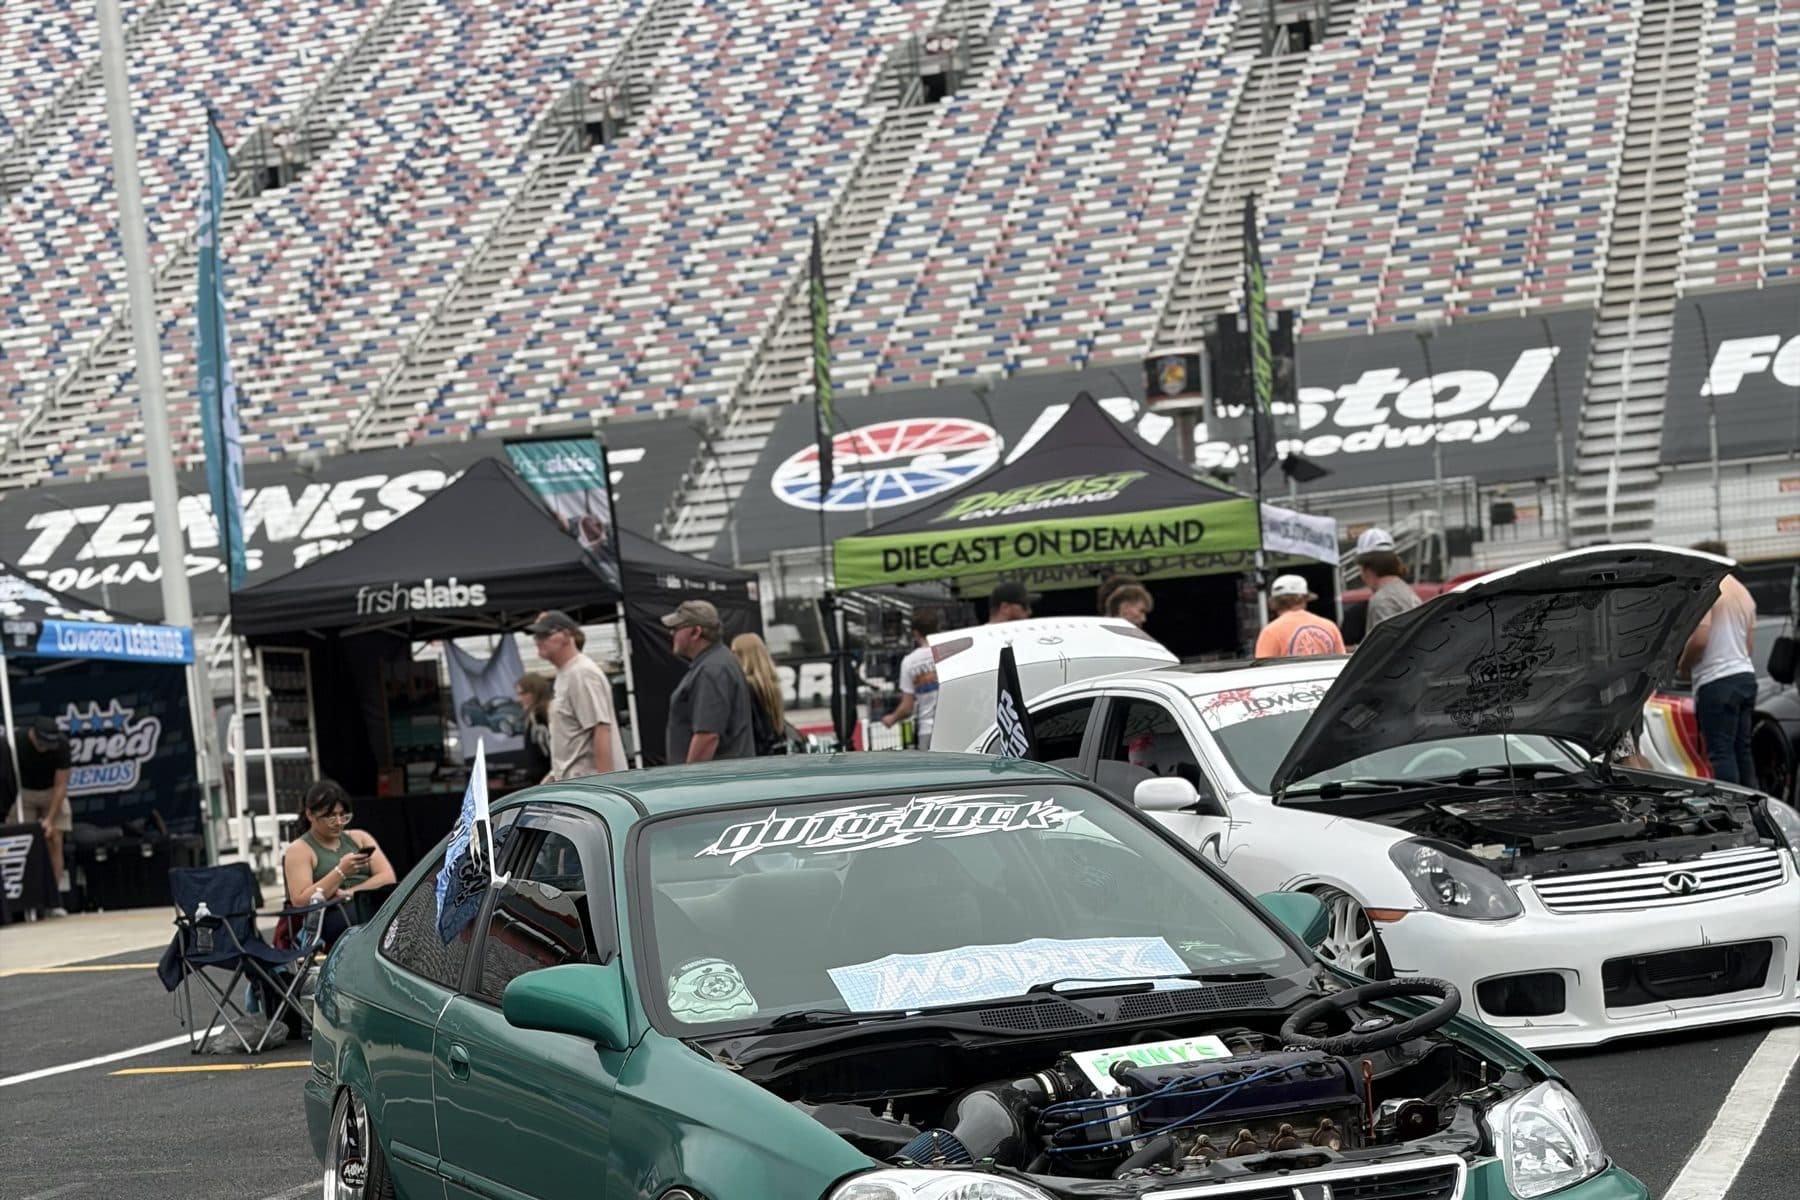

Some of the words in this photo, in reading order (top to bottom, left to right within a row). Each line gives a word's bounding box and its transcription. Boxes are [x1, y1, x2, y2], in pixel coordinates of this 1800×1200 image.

[882, 534, 1003, 573] DIECAST
[1013, 526, 1062, 559] ON
[1082, 518, 1206, 553] DEMAND
[355, 576, 487, 615] frshslabs
[55, 622, 123, 652] Lowered
[124, 622, 185, 659] LEGENDS
[69, 724, 157, 764] ered
[68, 762, 135, 790] GENDS
